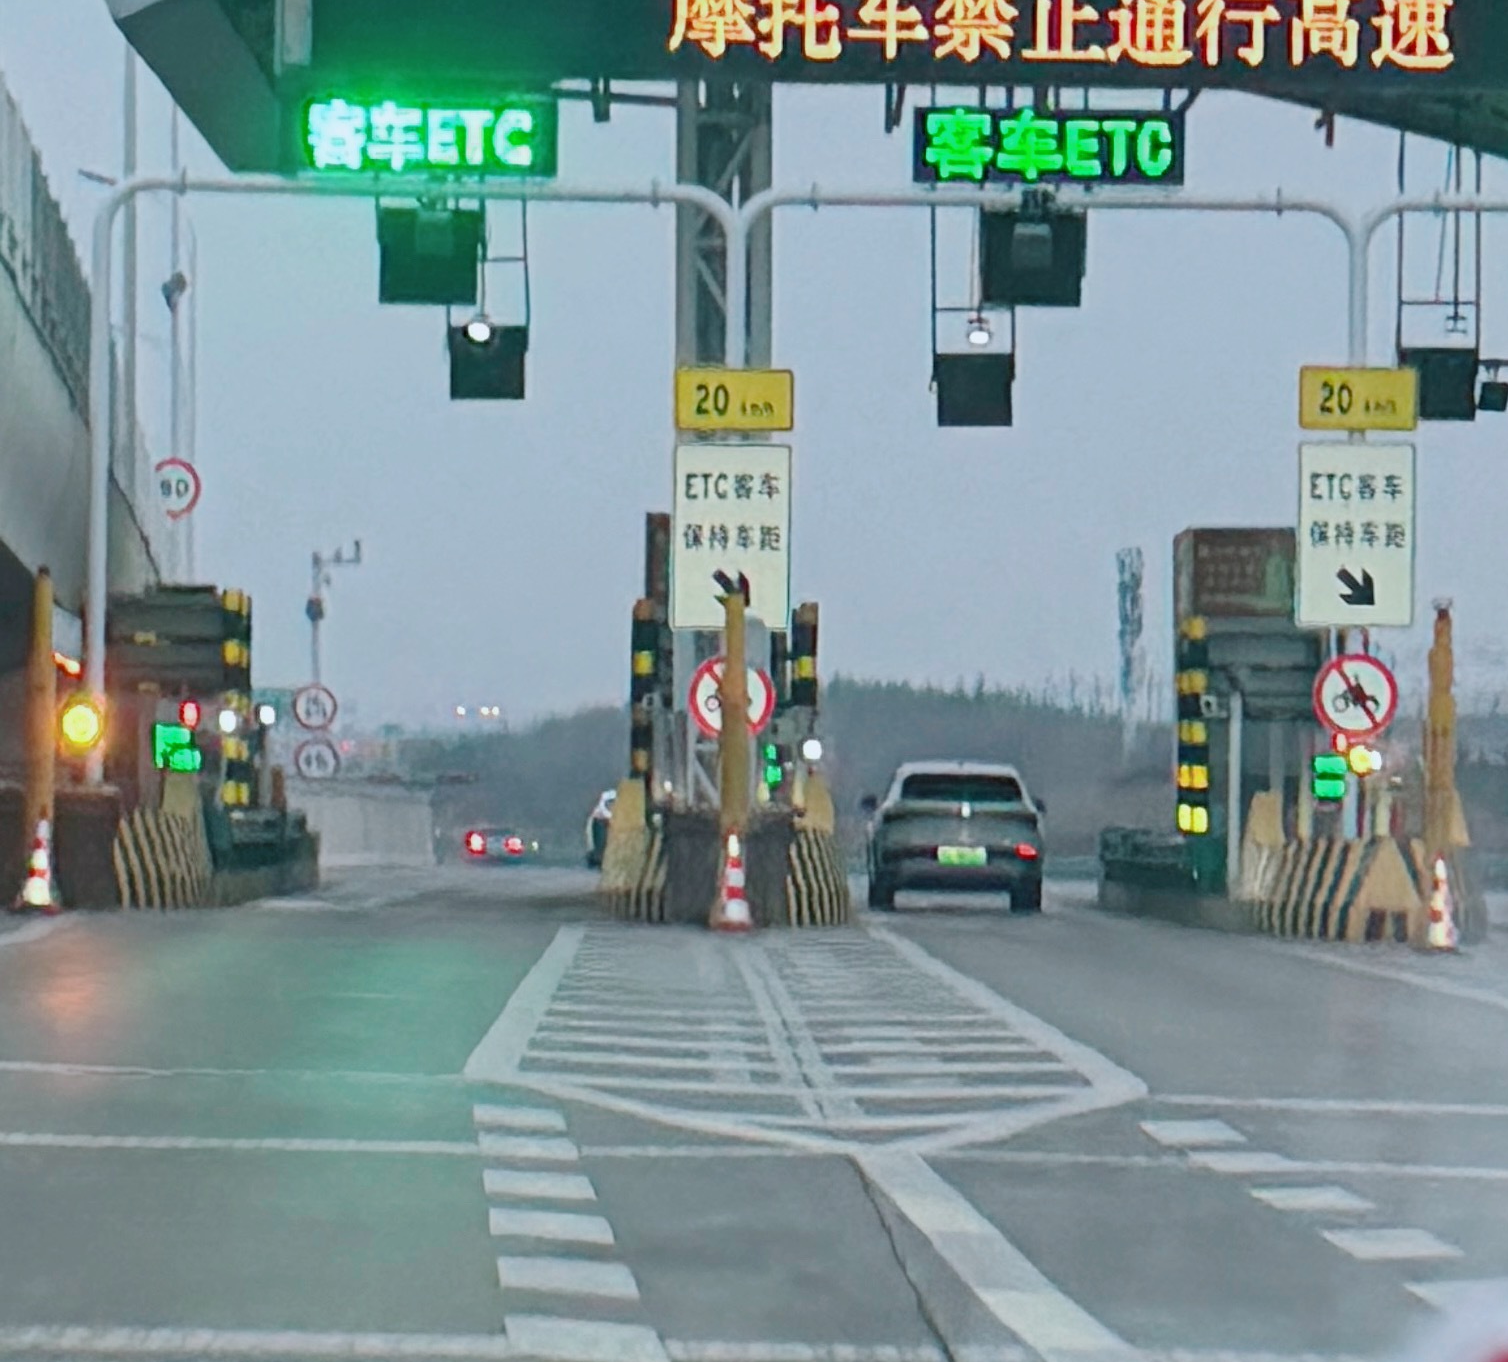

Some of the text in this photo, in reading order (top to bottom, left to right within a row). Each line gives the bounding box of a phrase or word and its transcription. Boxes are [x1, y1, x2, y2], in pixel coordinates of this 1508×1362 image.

[925, 108, 1173, 180] 客车ETC
[695, 383, 730, 417] 20
[1319, 380, 1353, 415] 20
[684, 472, 781, 501] ETC客车
[1309, 471, 1404, 501] ETC客车
